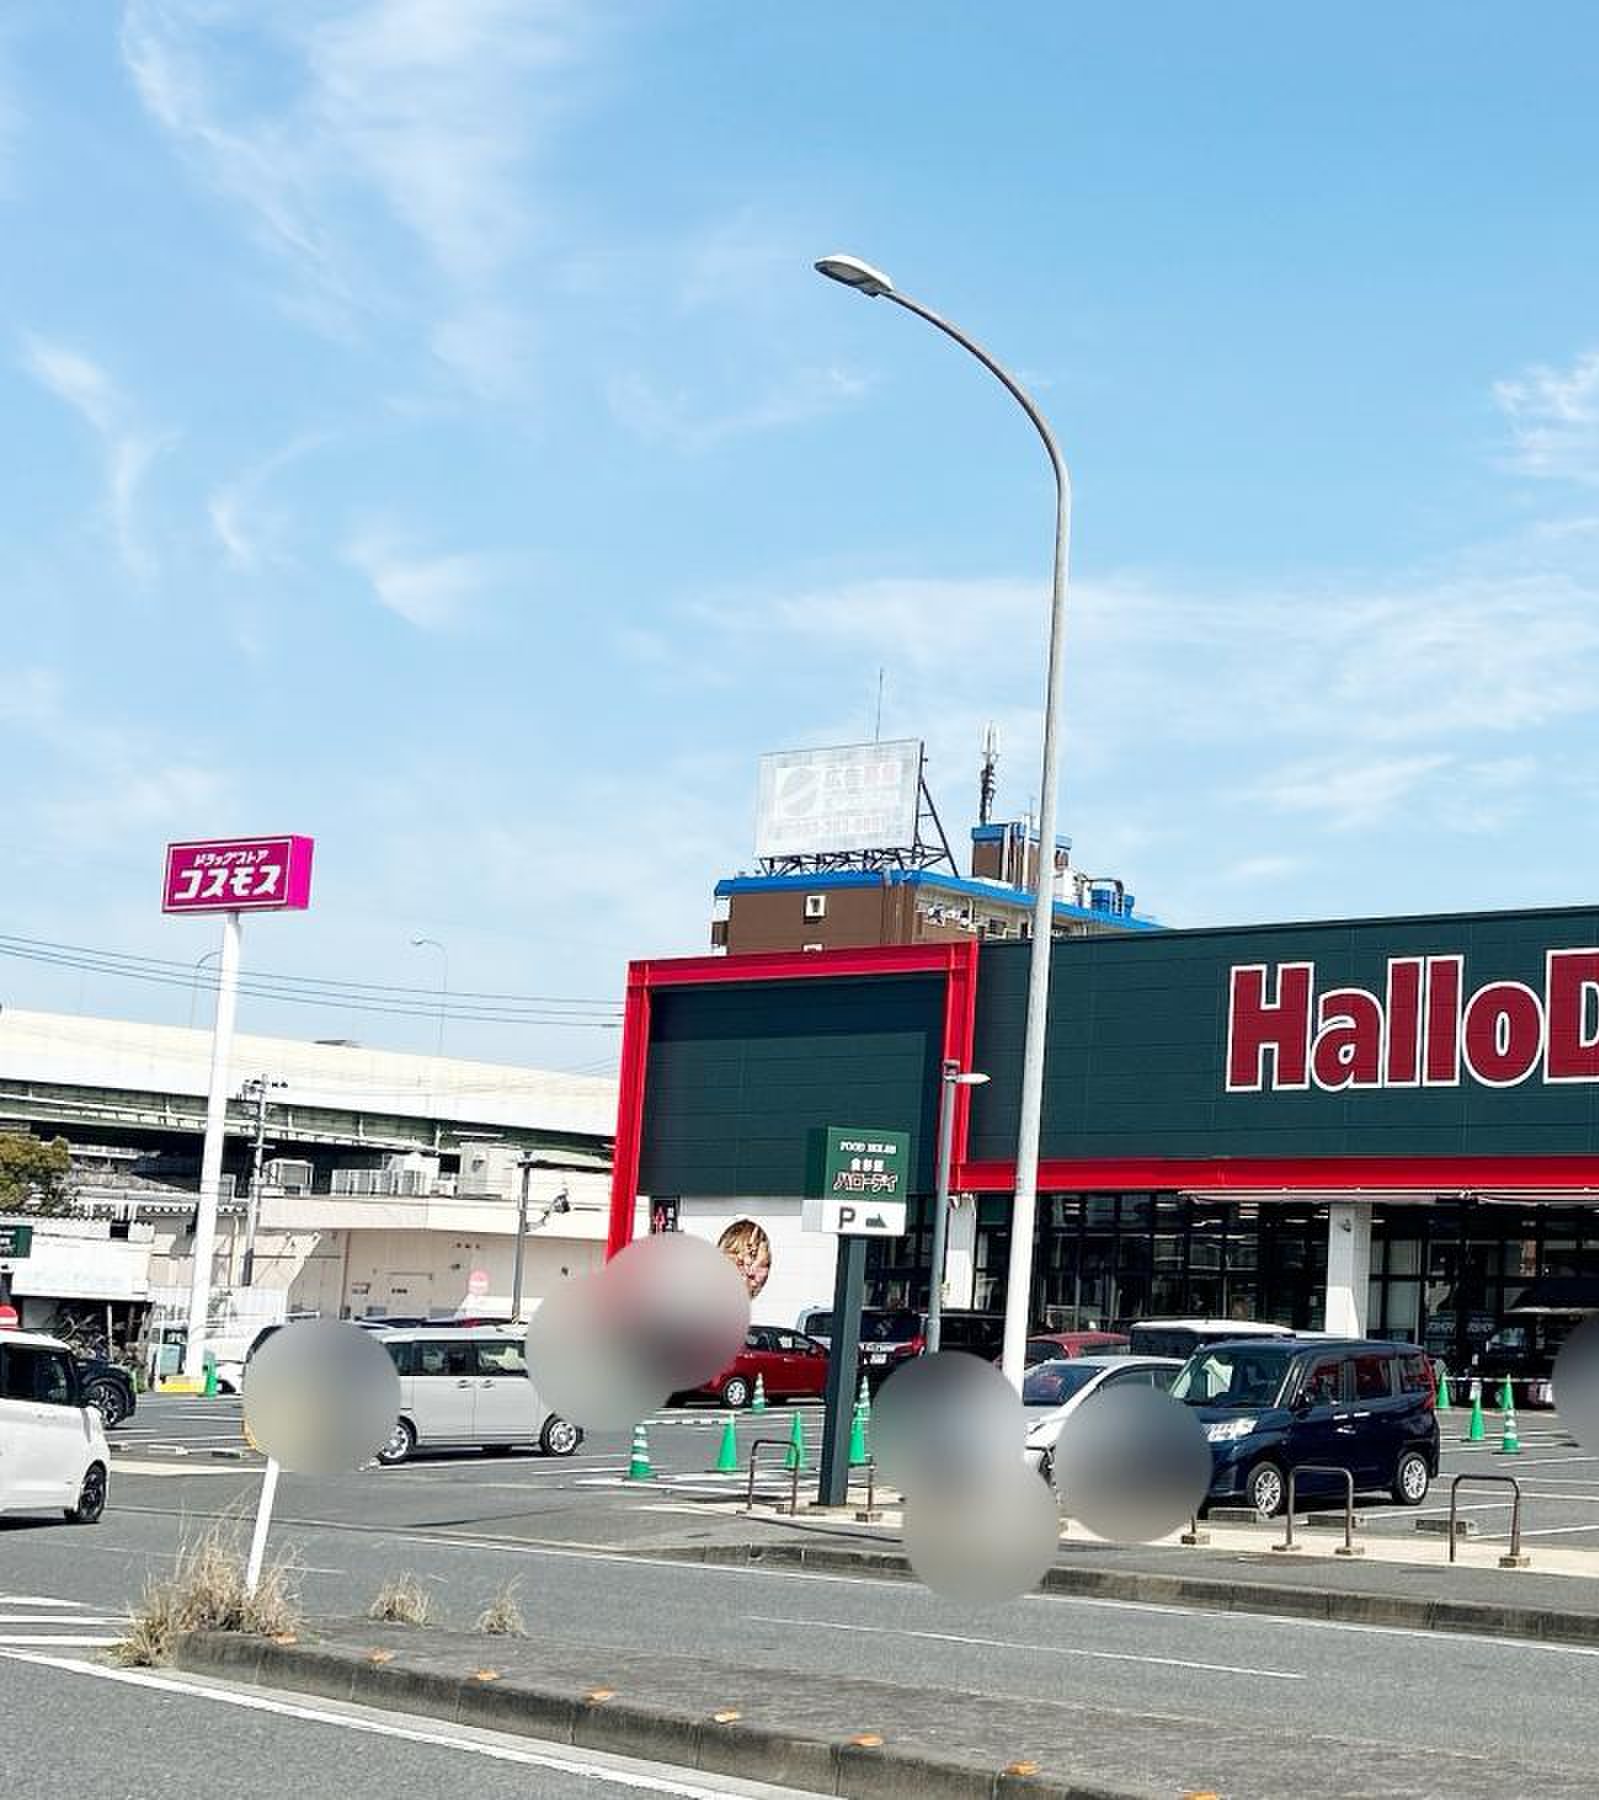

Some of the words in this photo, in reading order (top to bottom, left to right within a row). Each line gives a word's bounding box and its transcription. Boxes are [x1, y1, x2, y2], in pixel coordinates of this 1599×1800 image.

[194, 849, 270, 867] ドラッグストア
[173, 864, 282, 900] コスモス
[833, 1172, 898, 1192] ハローデイ
[838, 1206, 856, 1230] P
